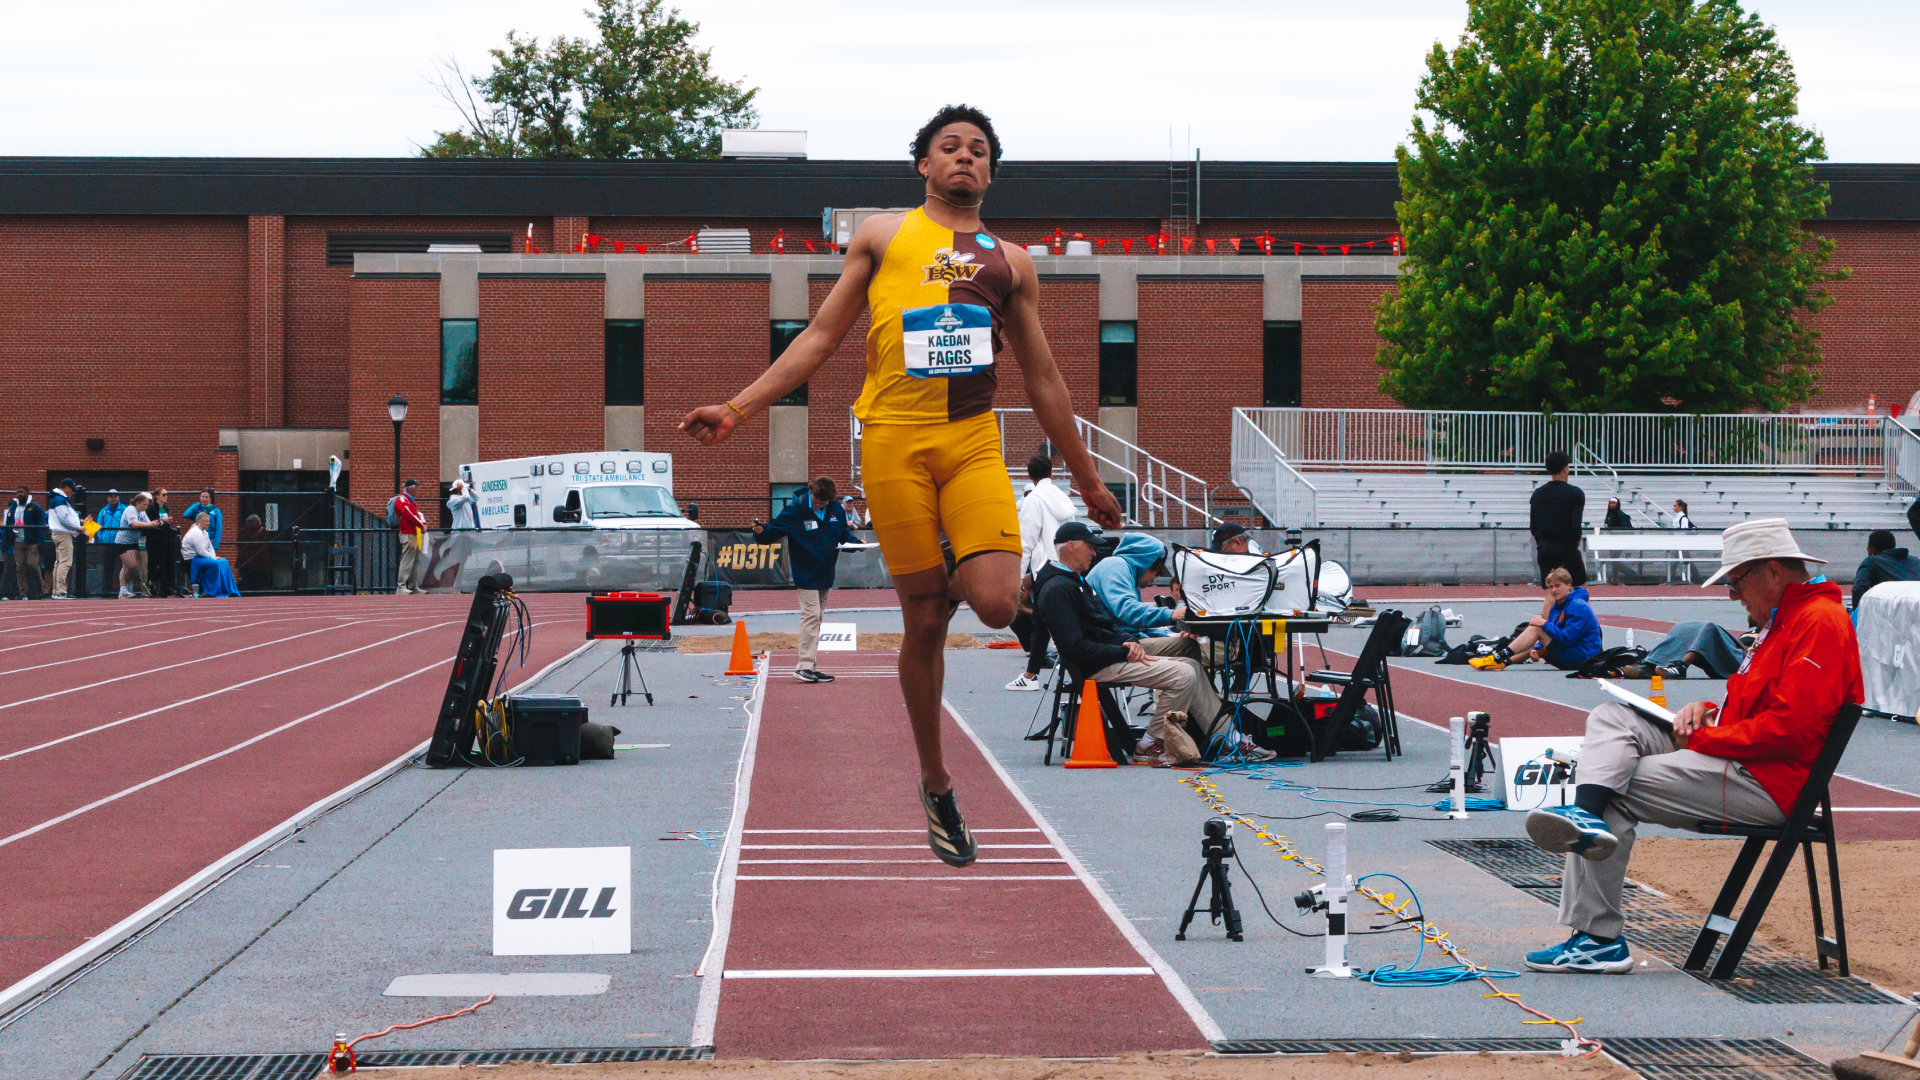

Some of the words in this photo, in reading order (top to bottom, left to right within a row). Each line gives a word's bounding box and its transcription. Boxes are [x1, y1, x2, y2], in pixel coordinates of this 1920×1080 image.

[928, 334, 971, 347] KAEDAN
[928, 349, 972, 366] FAGGS
[571, 474, 603, 482] TRI-STATE
[605, 473, 646, 481] AMBULANCE
[481, 479, 508, 493] GUNDERSEN
[481, 504, 510, 516] AMBULANCE
[716, 543, 782, 570] #D3TF
[1208, 574, 1225, 584] DV
[1202, 581, 1236, 593] SPORT
[818, 633, 852, 642] GILL
[506, 887, 618, 920] GILL
